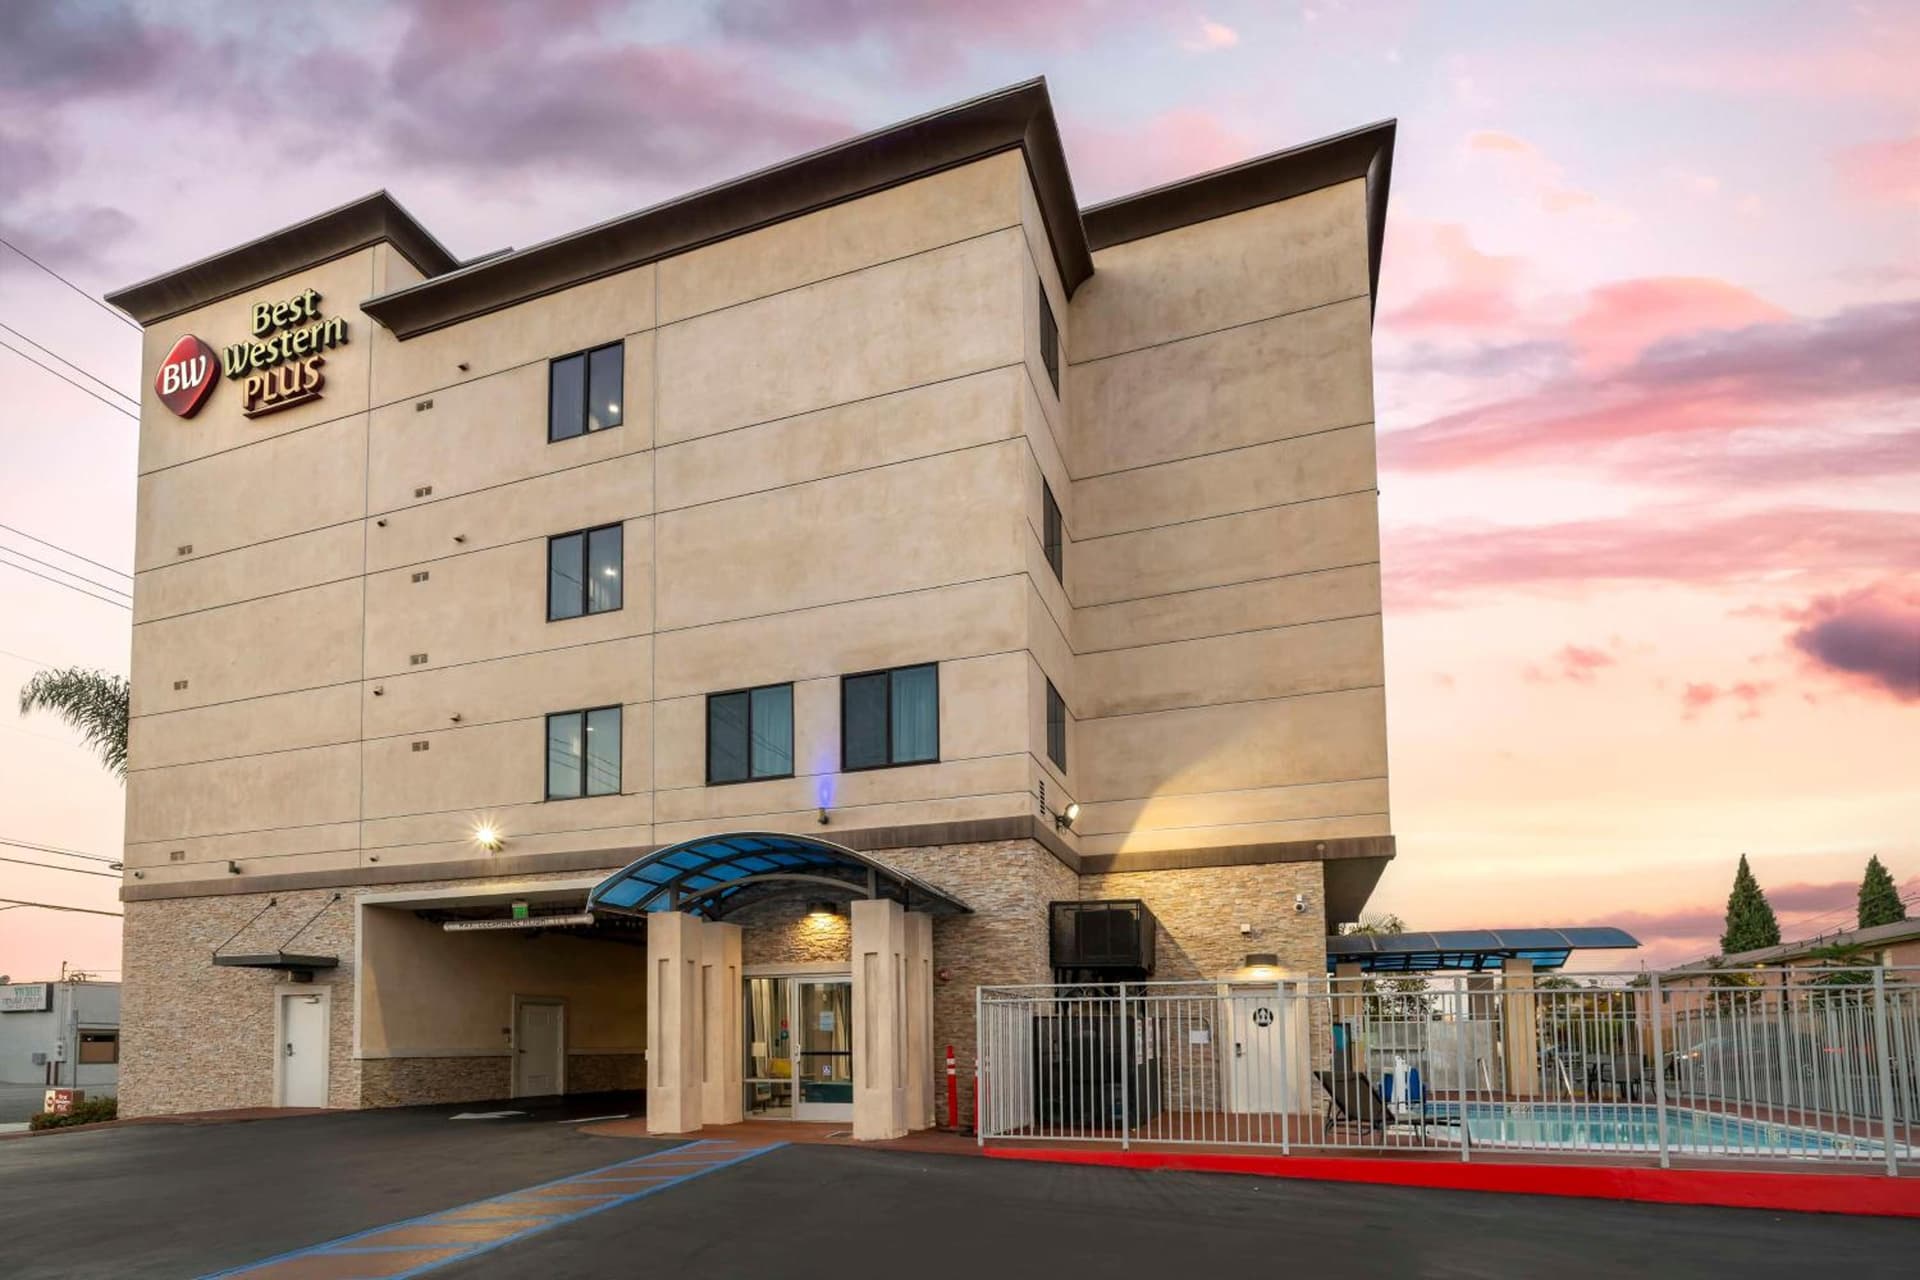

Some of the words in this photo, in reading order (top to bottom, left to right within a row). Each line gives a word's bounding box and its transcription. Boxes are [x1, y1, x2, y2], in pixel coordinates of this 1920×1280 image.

[252, 288, 321, 337] Best
[223, 316, 347, 379] Western
[162, 355, 207, 395] BW
[243, 356, 324, 410] PLUS
